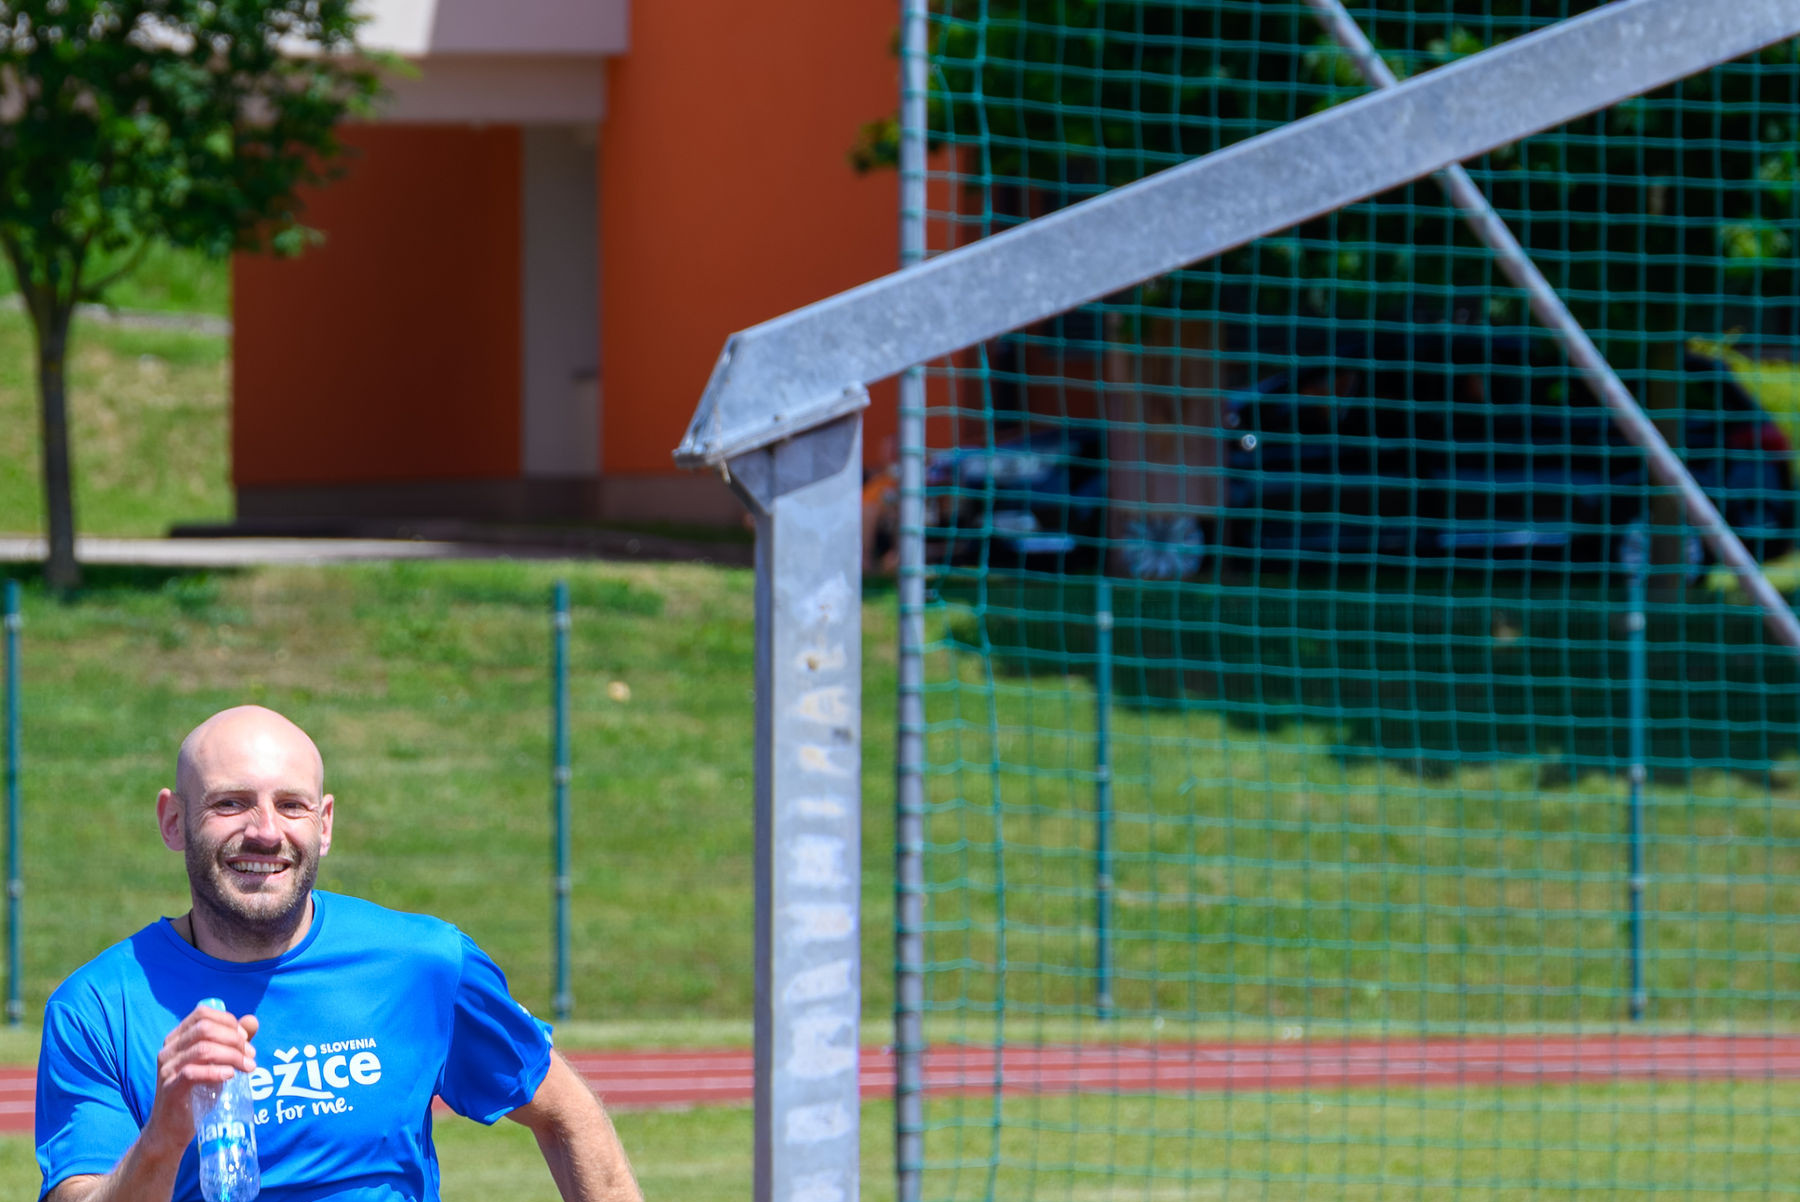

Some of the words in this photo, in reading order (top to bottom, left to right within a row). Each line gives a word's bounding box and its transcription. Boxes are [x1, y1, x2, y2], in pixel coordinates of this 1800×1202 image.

[320, 1038, 377, 1054] SLOVENIA
[250, 1045, 382, 1100] ežice
[275, 1099, 306, 1124] for
[312, 1097, 353, 1115] me.
